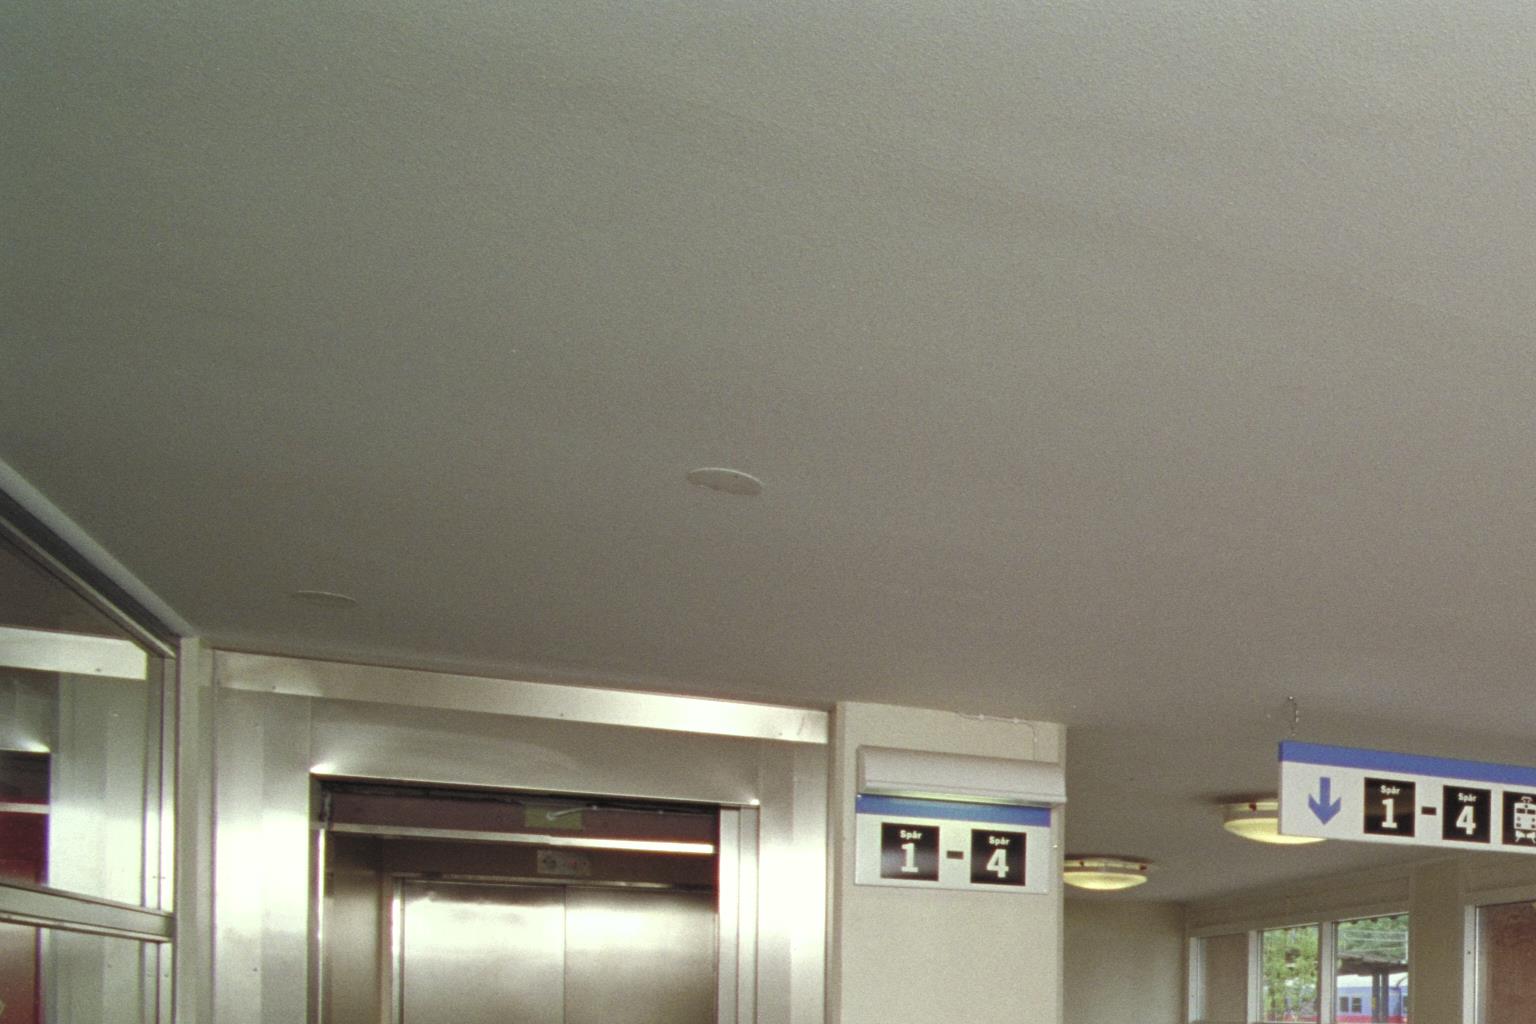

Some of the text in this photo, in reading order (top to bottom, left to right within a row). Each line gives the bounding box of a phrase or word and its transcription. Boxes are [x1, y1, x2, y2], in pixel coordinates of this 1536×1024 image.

[1380, 784, 1400, 795] Spår
[1457, 792, 1477, 802] Spår
[1382, 798, 1398, 829] 1
[1455, 805, 1476, 835] 4
[899, 829, 923, 840] Spår
[988, 835, 1011, 846] Spår
[901, 842, 919, 873] 1
[986, 848, 1010, 879] 4
